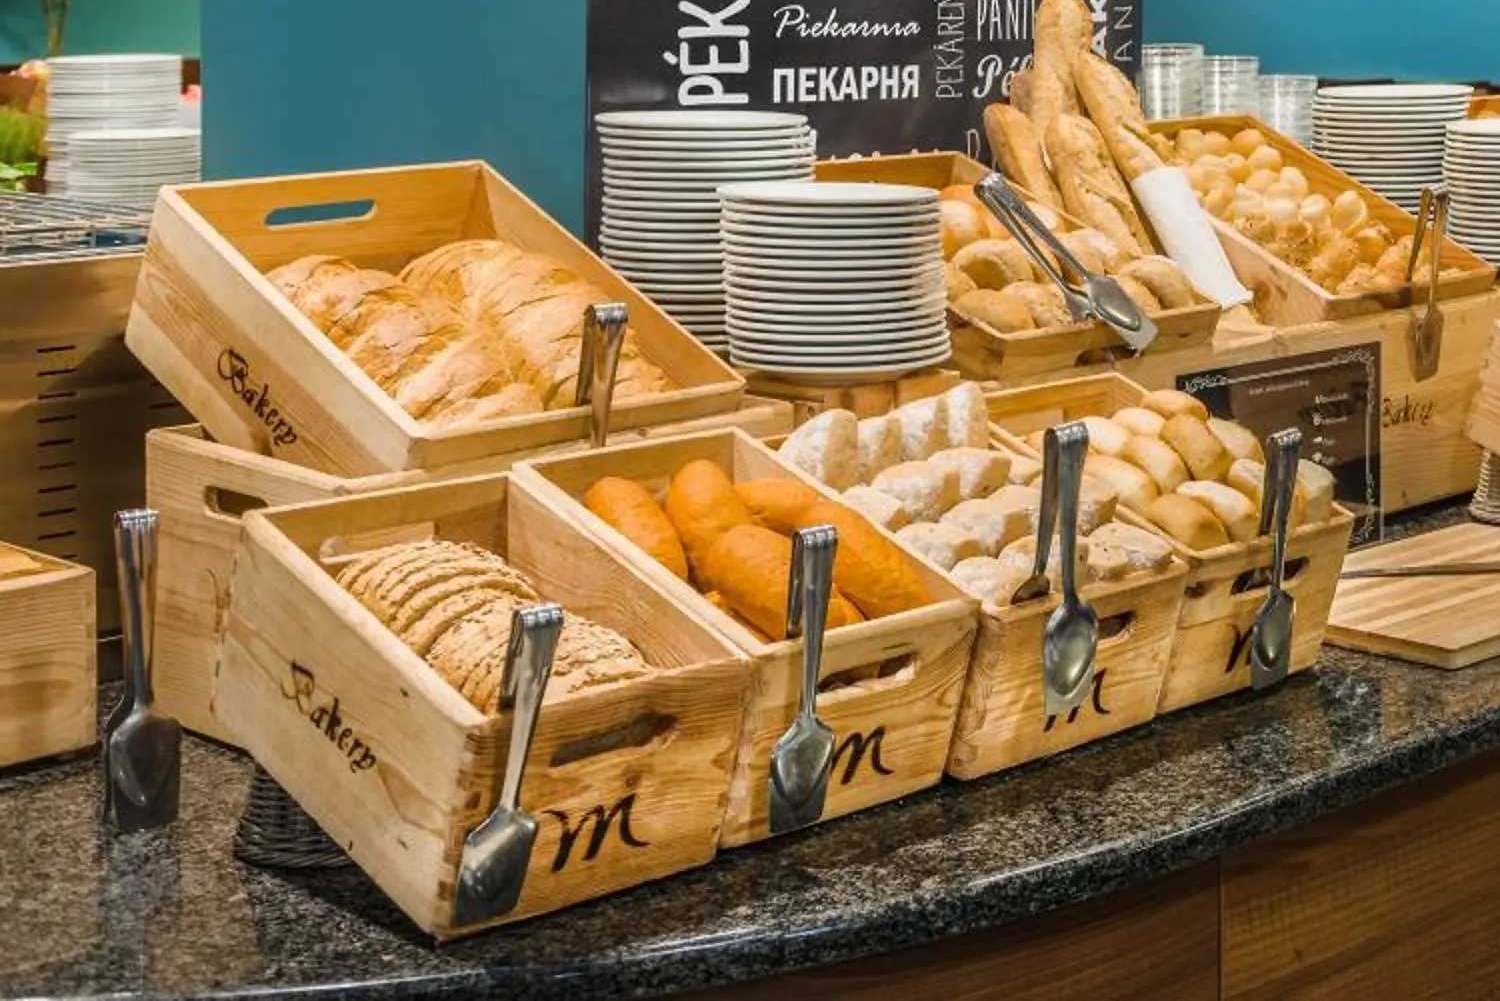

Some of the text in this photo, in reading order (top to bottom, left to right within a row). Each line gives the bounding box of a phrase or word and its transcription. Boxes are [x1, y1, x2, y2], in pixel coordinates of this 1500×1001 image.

[772, 3, 922, 40] Piekarnia
[773, 64, 921, 104] ПЕКАРНЯ
[217, 348, 298, 449] Bakery
[279, 659, 377, 775] Bakery
